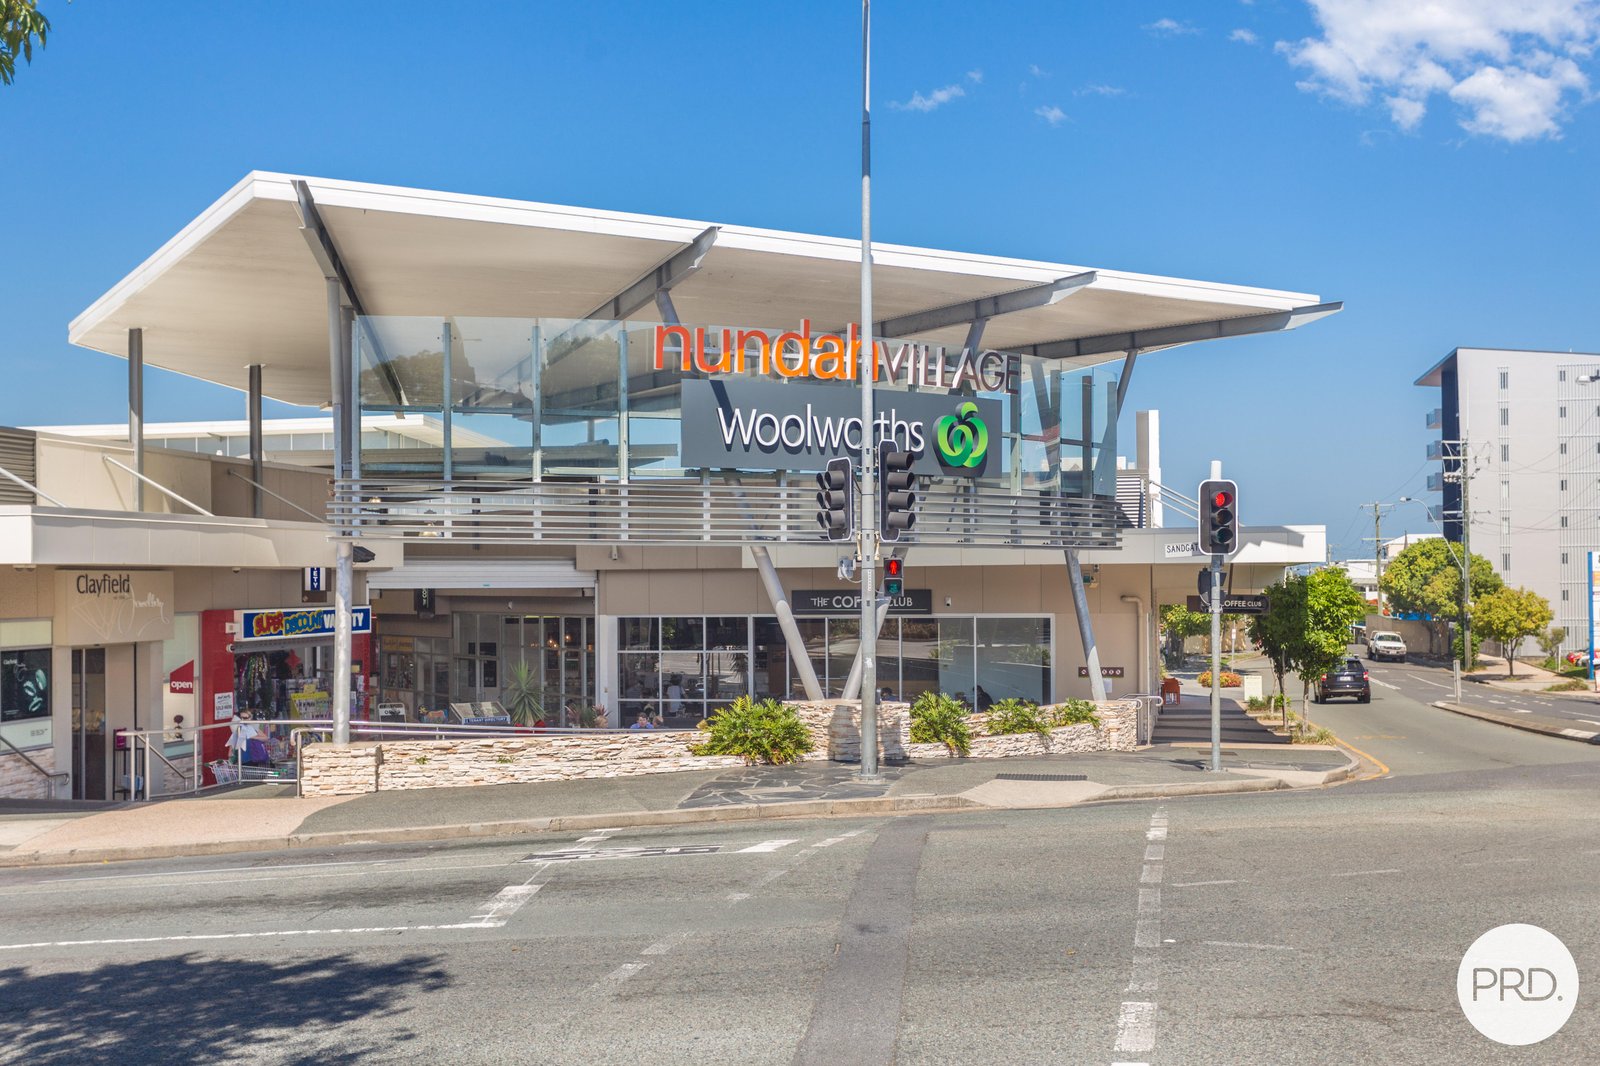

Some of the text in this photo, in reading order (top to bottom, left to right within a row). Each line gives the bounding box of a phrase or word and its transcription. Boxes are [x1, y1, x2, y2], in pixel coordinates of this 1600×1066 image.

[654, 318, 1022, 395] nundah VILLAGE
[1166, 543, 1200, 554] SANDGAT
[76, 573, 130, 598] Clayfield
[810, 597, 830, 606] THE
[832, 595, 862, 608] COF
[253, 610, 364, 636] SUPER DISCOUNT VATY
[170, 681, 193, 690] open
